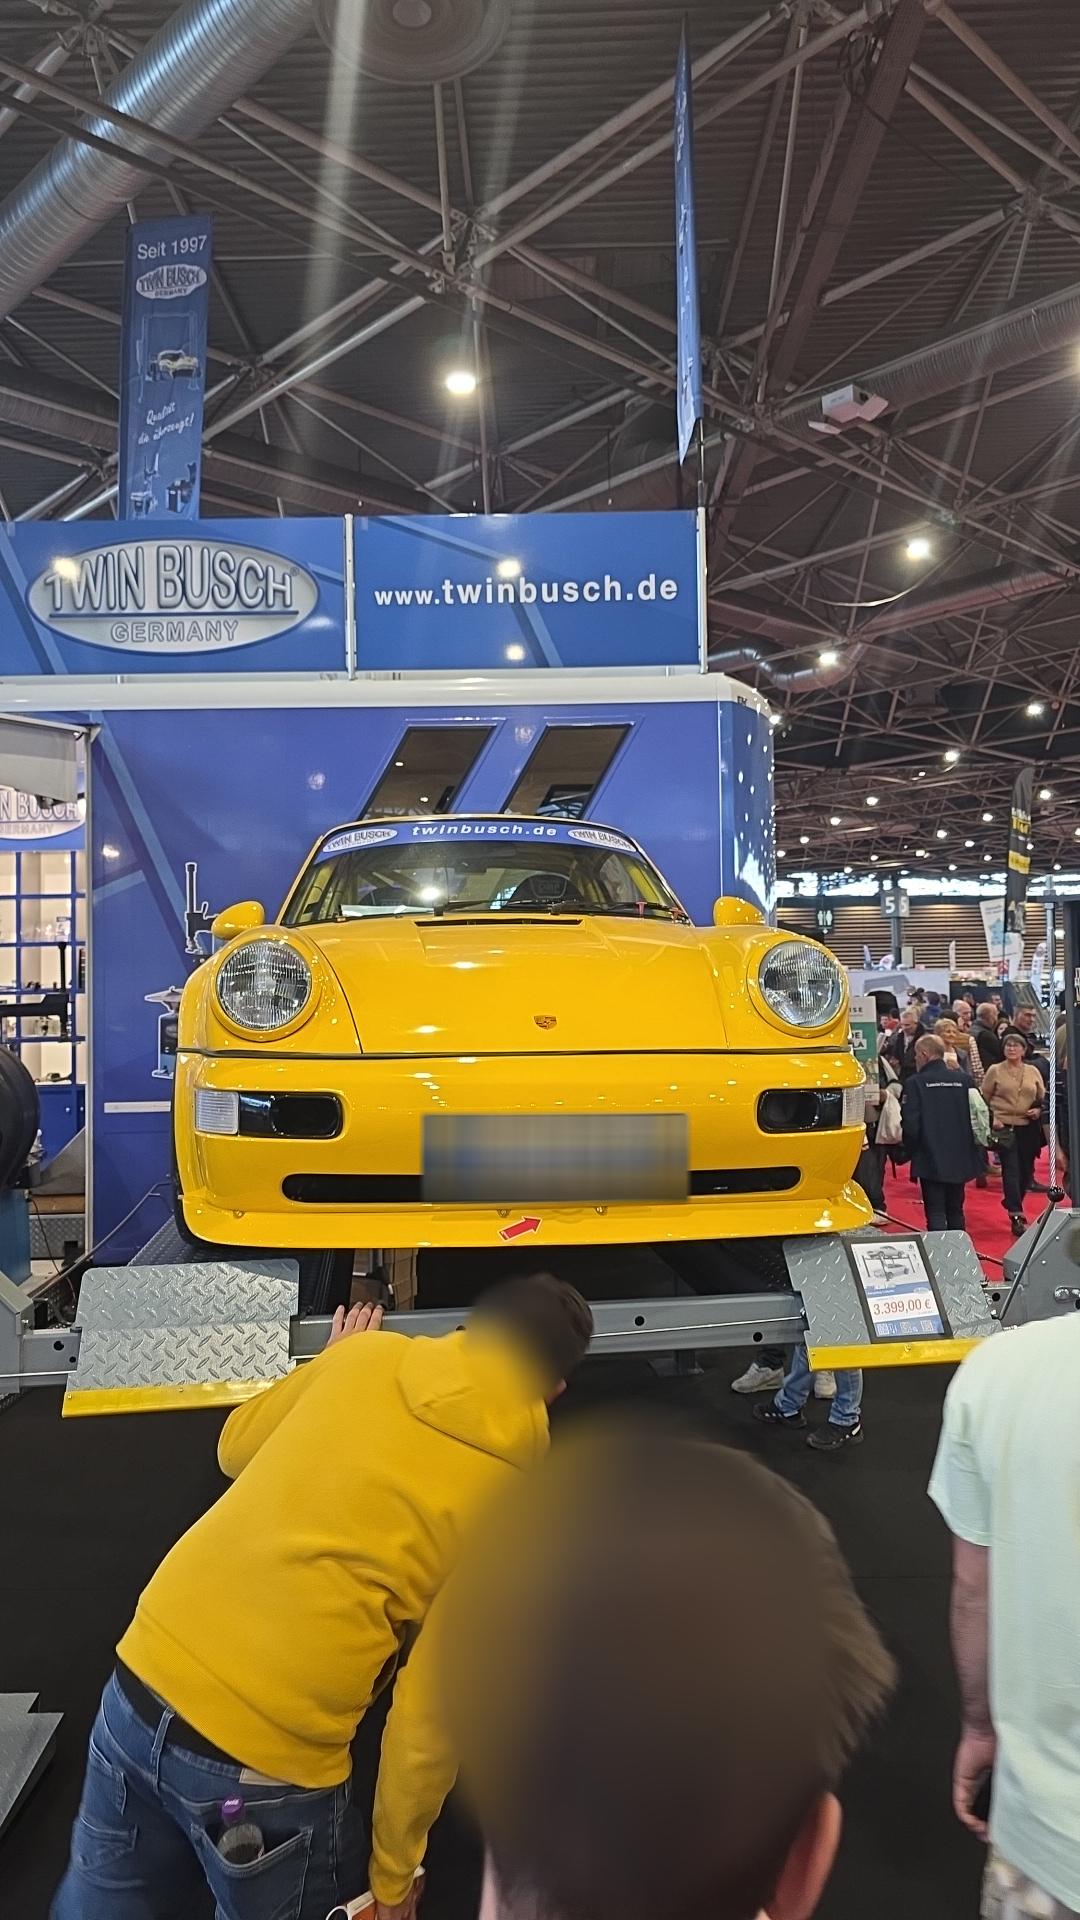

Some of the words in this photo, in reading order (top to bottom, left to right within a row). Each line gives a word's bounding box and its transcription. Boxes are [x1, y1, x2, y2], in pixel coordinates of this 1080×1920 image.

[137, 242, 166, 260] Seit
[171, 234, 208, 255] 1997
[44, 546, 145, 611] TWIN
[156, 545, 292, 609] BUSCH
[374, 574, 678, 605] www.twinbusch.de
[111, 620, 239, 642] GERMANY
[353, 830, 392, 842] BUSCH
[412, 824, 557, 836] twinbusch.de
[885, 897, 896, 914] 5
[900, 897, 908, 914] 5
[873, 1298, 922, 1316] 3.399,00
[925, 1299, 932, 1310] €
